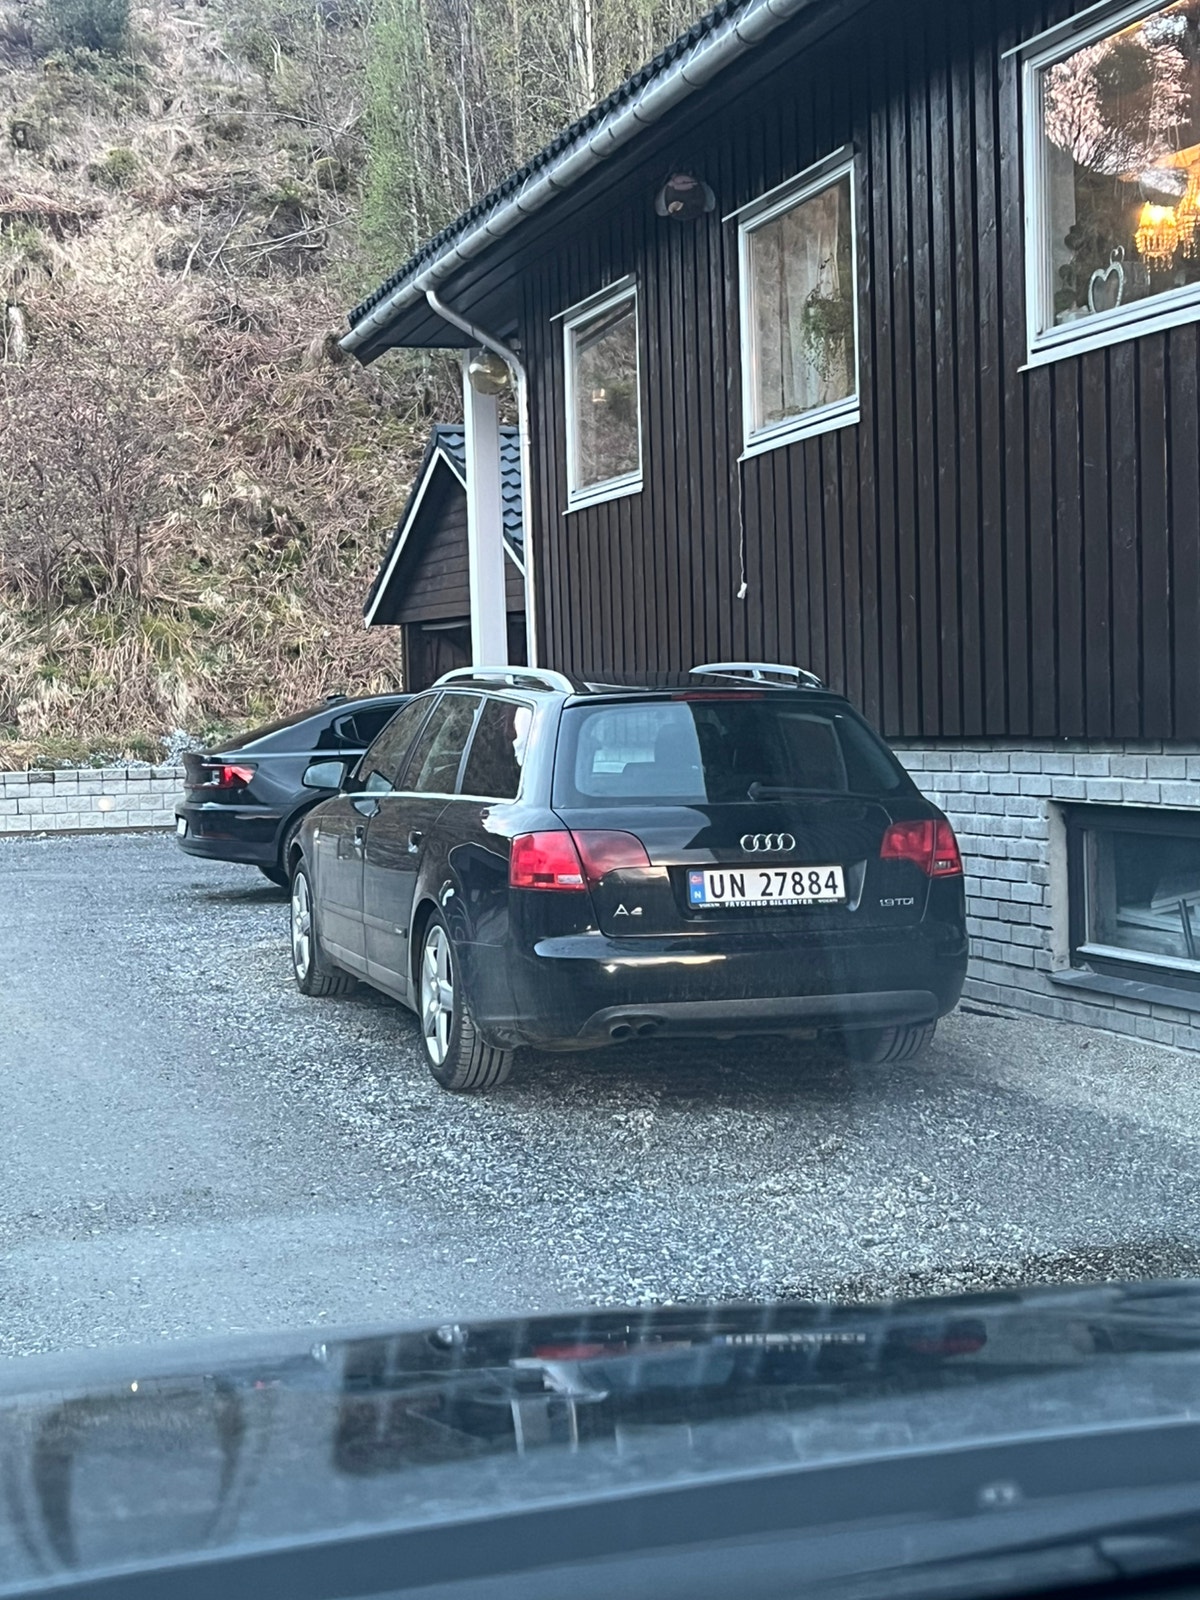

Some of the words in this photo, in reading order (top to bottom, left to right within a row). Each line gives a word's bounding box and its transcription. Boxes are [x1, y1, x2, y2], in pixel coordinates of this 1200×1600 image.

[709, 873, 746, 899] UN
[758, 870, 839, 897] 27884
[694, 891, 702, 899] N
[612, 903, 643, 919] A4
